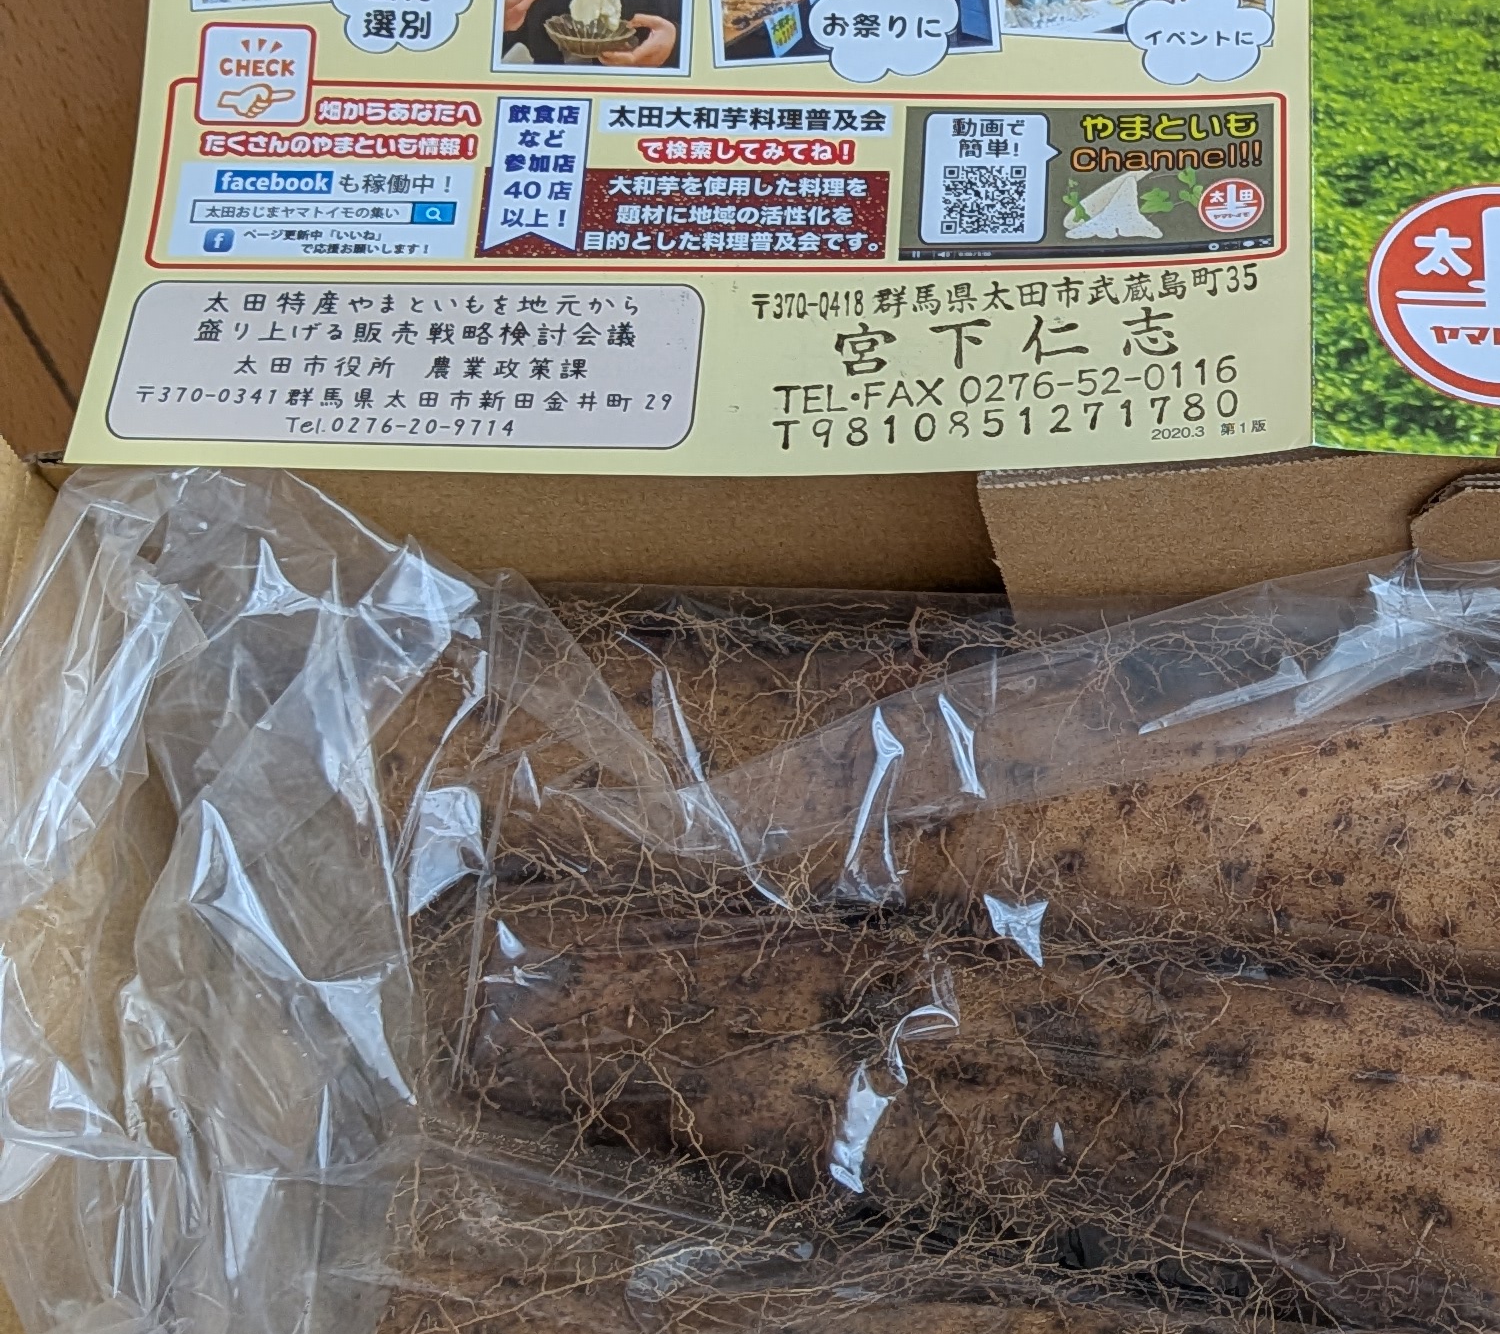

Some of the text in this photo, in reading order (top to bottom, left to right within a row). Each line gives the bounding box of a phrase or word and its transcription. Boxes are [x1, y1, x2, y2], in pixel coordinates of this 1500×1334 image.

[363, 9, 432, 40] 選別
[822, 12, 943, 40] お祭りに
[1144, 27, 1254, 48] イベントに
[219, 57, 296, 77] CHECK
[317, 99, 479, 123] 畑からあなたへ
[508, 104, 580, 125] 飲食店
[608, 105, 887, 133] 太田大和芋料理普及会
[951, 117, 1026, 138] 動画で
[1082, 112, 1259, 141] やまといも
[519, 128, 564, 149] など
[642, 140, 850, 161] で検索してみてね！
[1071, 142, 1263, 171] Channel!!
[504, 154, 576, 173] 参加店
[220, 173, 330, 193] facebook
[608, 175, 867, 198] 大和芋を使用した料理を
[616, 205, 853, 227] 題材に地域の活性化を
[583, 230, 881, 252] 目的とした料理普及会です。
[203, 289, 640, 317] 太田特産やまといもを地元から
[194, 319, 637, 347] 盛り上げる販売戦略検討会議
[834, 306, 1181, 377] 宮下仁志
[233, 354, 589, 381] 太田市役所 農業政策課
[960, 354, 1238, 406] 0276-52-0116
[1151, 426, 1206, 441] 2020.3
